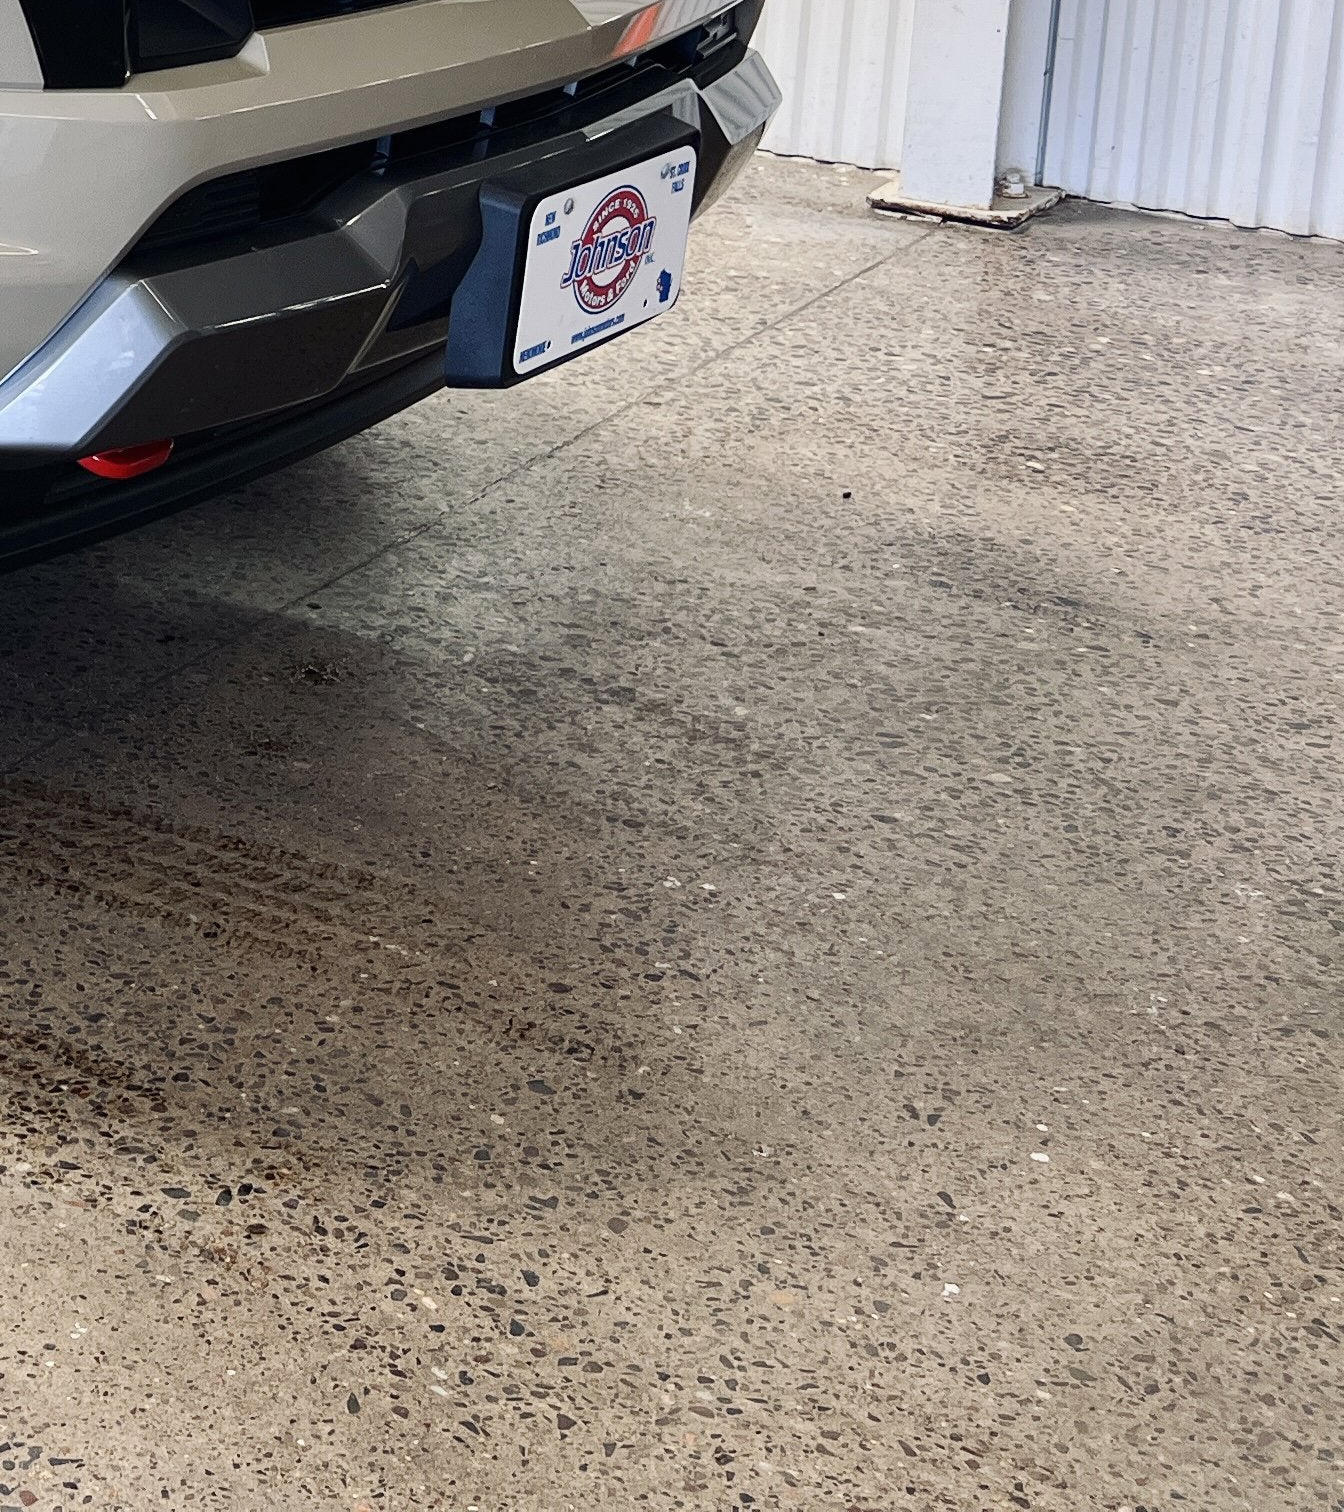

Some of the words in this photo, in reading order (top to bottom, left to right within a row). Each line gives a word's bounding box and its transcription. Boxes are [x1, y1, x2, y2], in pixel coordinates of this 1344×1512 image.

[593, 198, 621, 232] SINCE
[561, 217, 656, 288] Johnson
[579, 279, 606, 306] Motors
